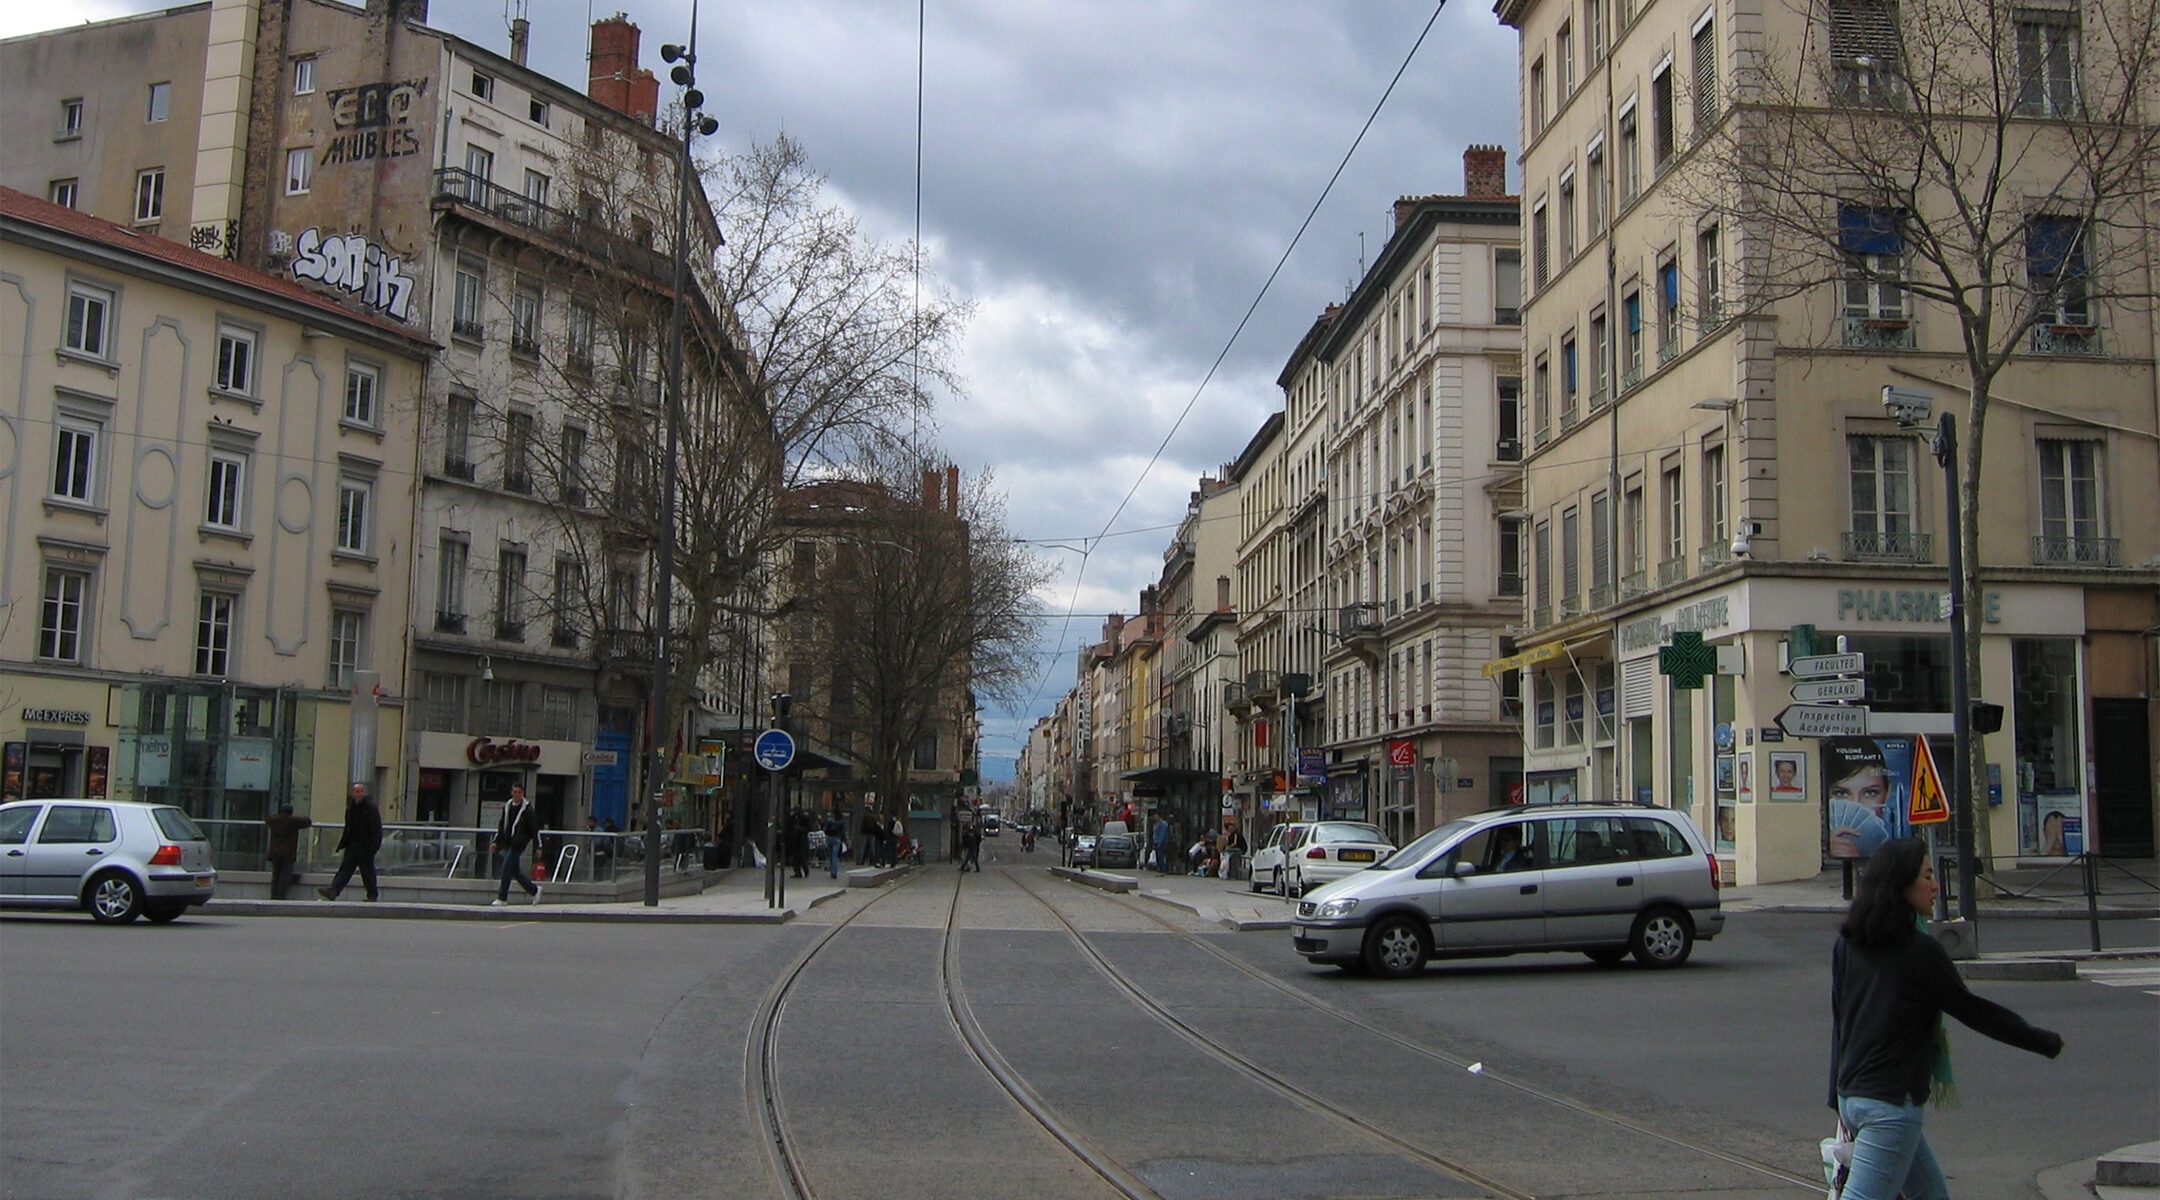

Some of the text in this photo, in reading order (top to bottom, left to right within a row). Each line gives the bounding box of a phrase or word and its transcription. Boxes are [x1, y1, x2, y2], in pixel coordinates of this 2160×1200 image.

[1838, 590, 2001, 624] PHARME
[1815, 658, 1855, 671] FACULTES
[1817, 684, 1856, 697] GERLAND
[1799, 711, 1857, 724] Inspection
[1799, 722, 1862, 736] Académique
[466, 737, 542, 765] Casino
